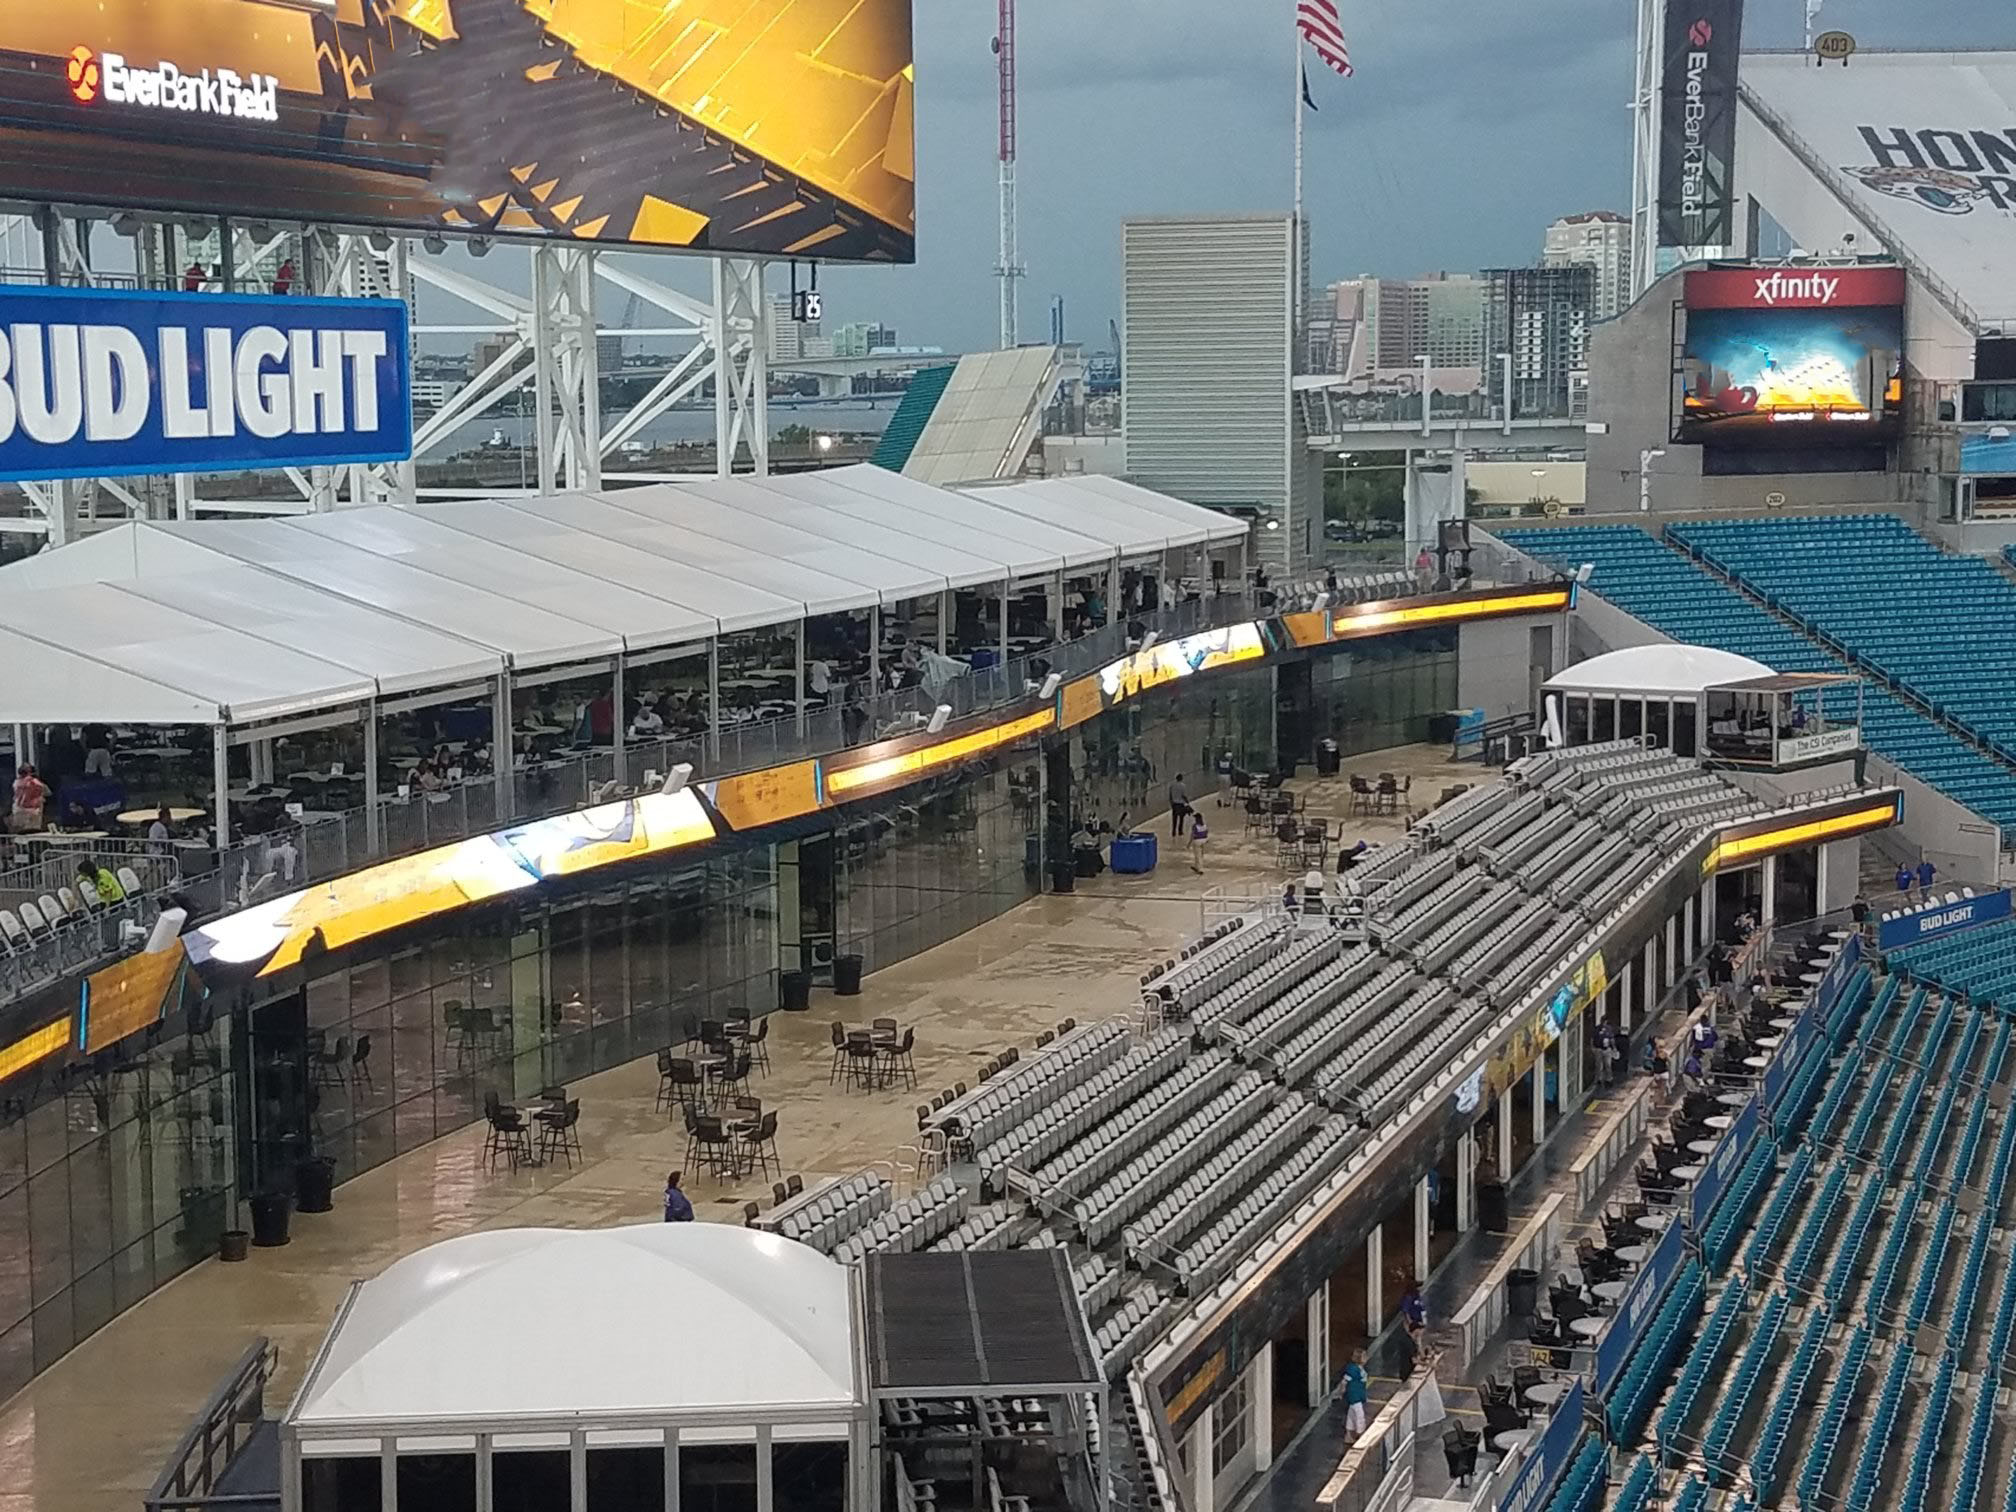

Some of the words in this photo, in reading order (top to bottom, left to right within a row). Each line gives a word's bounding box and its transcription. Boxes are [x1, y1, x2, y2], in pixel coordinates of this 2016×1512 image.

[1822, 37, 1848, 52] 403
[1754, 272, 1839, 304] xfinity
[158, 326, 387, 438] LIGHT
[1920, 914, 1943, 932] BUD
[1943, 906, 1974, 926] LIGHT
